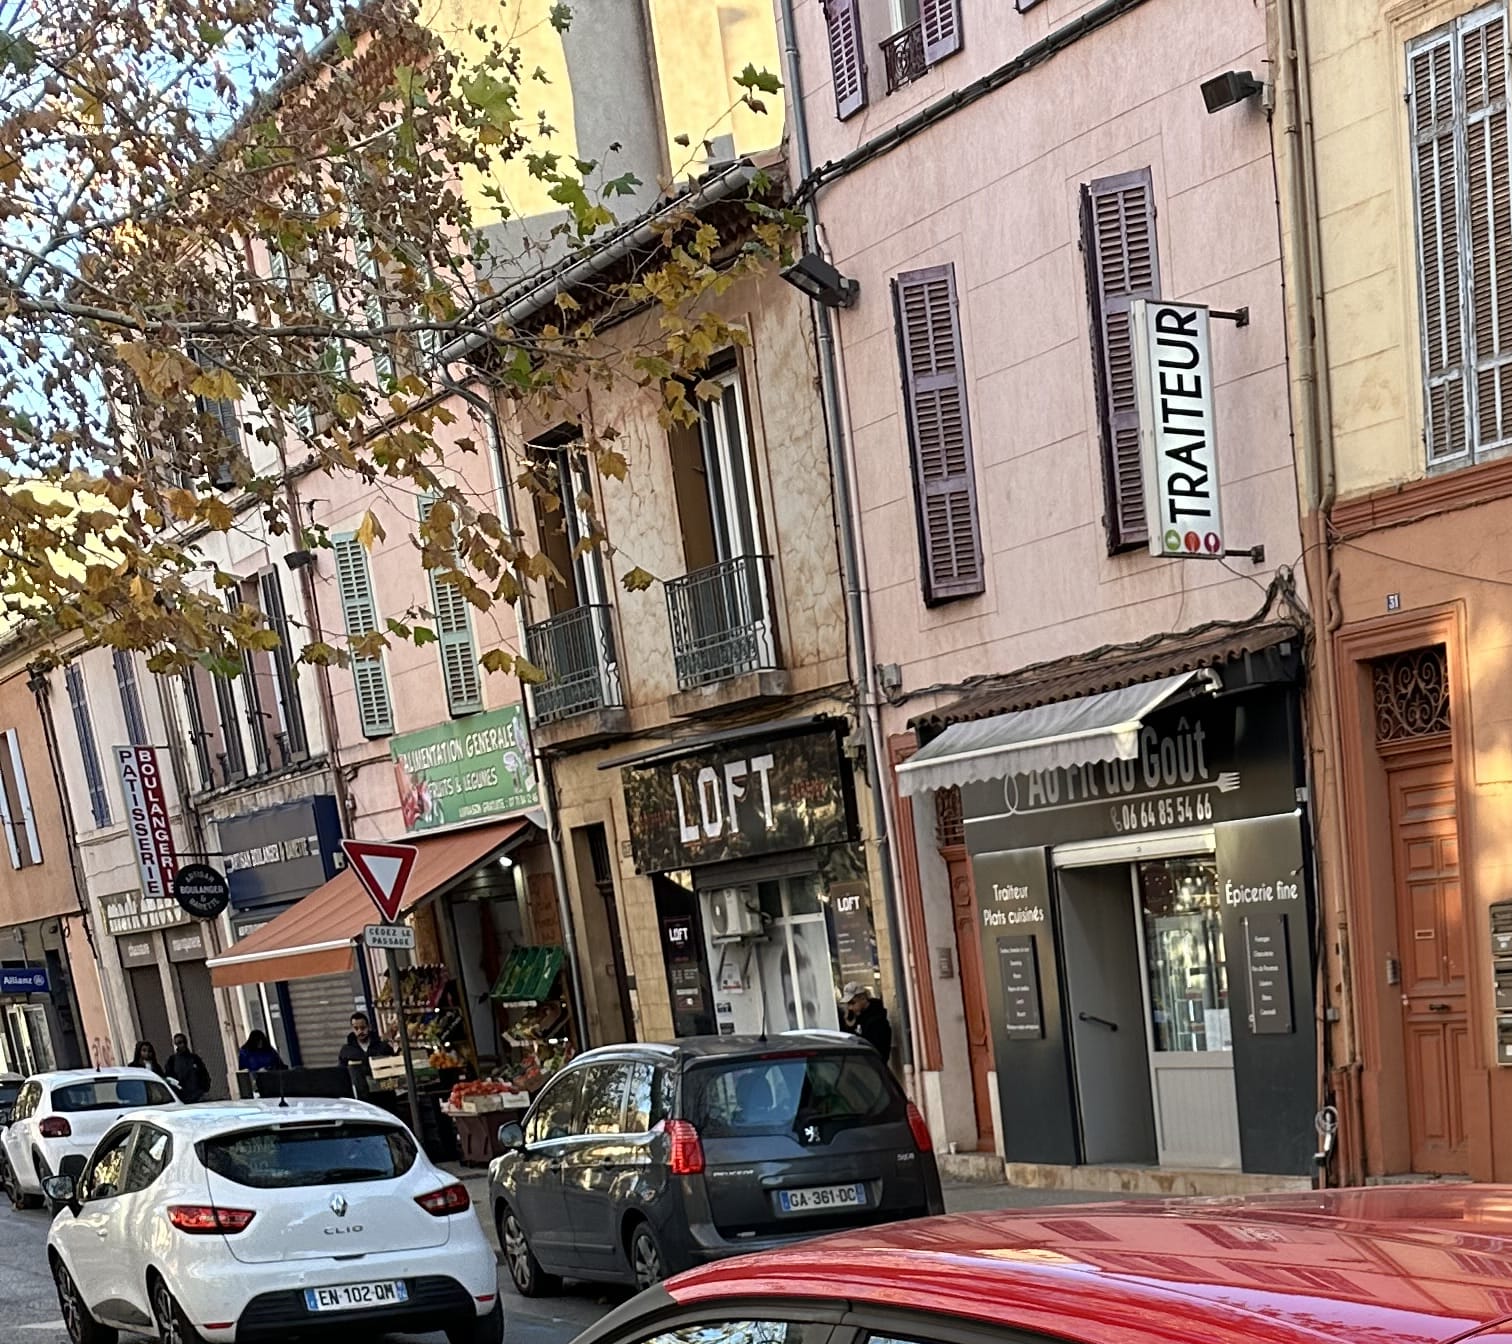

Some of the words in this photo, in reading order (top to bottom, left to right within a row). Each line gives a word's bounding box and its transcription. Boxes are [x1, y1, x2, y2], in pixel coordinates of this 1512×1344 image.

[1155, 308, 1211, 523] TRAITEUR
[402, 738, 463, 773] ALIMENTATION
[465, 724, 516, 758] GENERALE
[1141, 716, 1208, 788] Goût
[672, 753, 775, 843] LOFT
[119, 751, 159, 893] PATISSERIE
[138, 751, 174, 893] BOULANGERIE
[1121, 804, 1137, 831] 06
[1140, 802, 1156, 828] 64
[1158, 799, 1174, 825] 85
[1177, 796, 1193, 822] 54
[1196, 793, 1212, 820] 66
[180, 885, 223, 894] BOULANGER
[992, 883, 1029, 901] Traiteur
[1225, 879, 1274, 907] Épicerie
[1276, 880, 1298, 900] fine
[837, 895, 860, 912] LOFT
[983, 909, 1006, 926] Plats
[1008, 905, 1045, 924] cuisinés
[372, 936, 409, 945] PASSAGE
[402, 929, 411, 937] LE
[668, 927, 688, 942] LOFT
[3, 976, 33, 985] Allianz
[323, 1225, 363, 1235] CLIO
